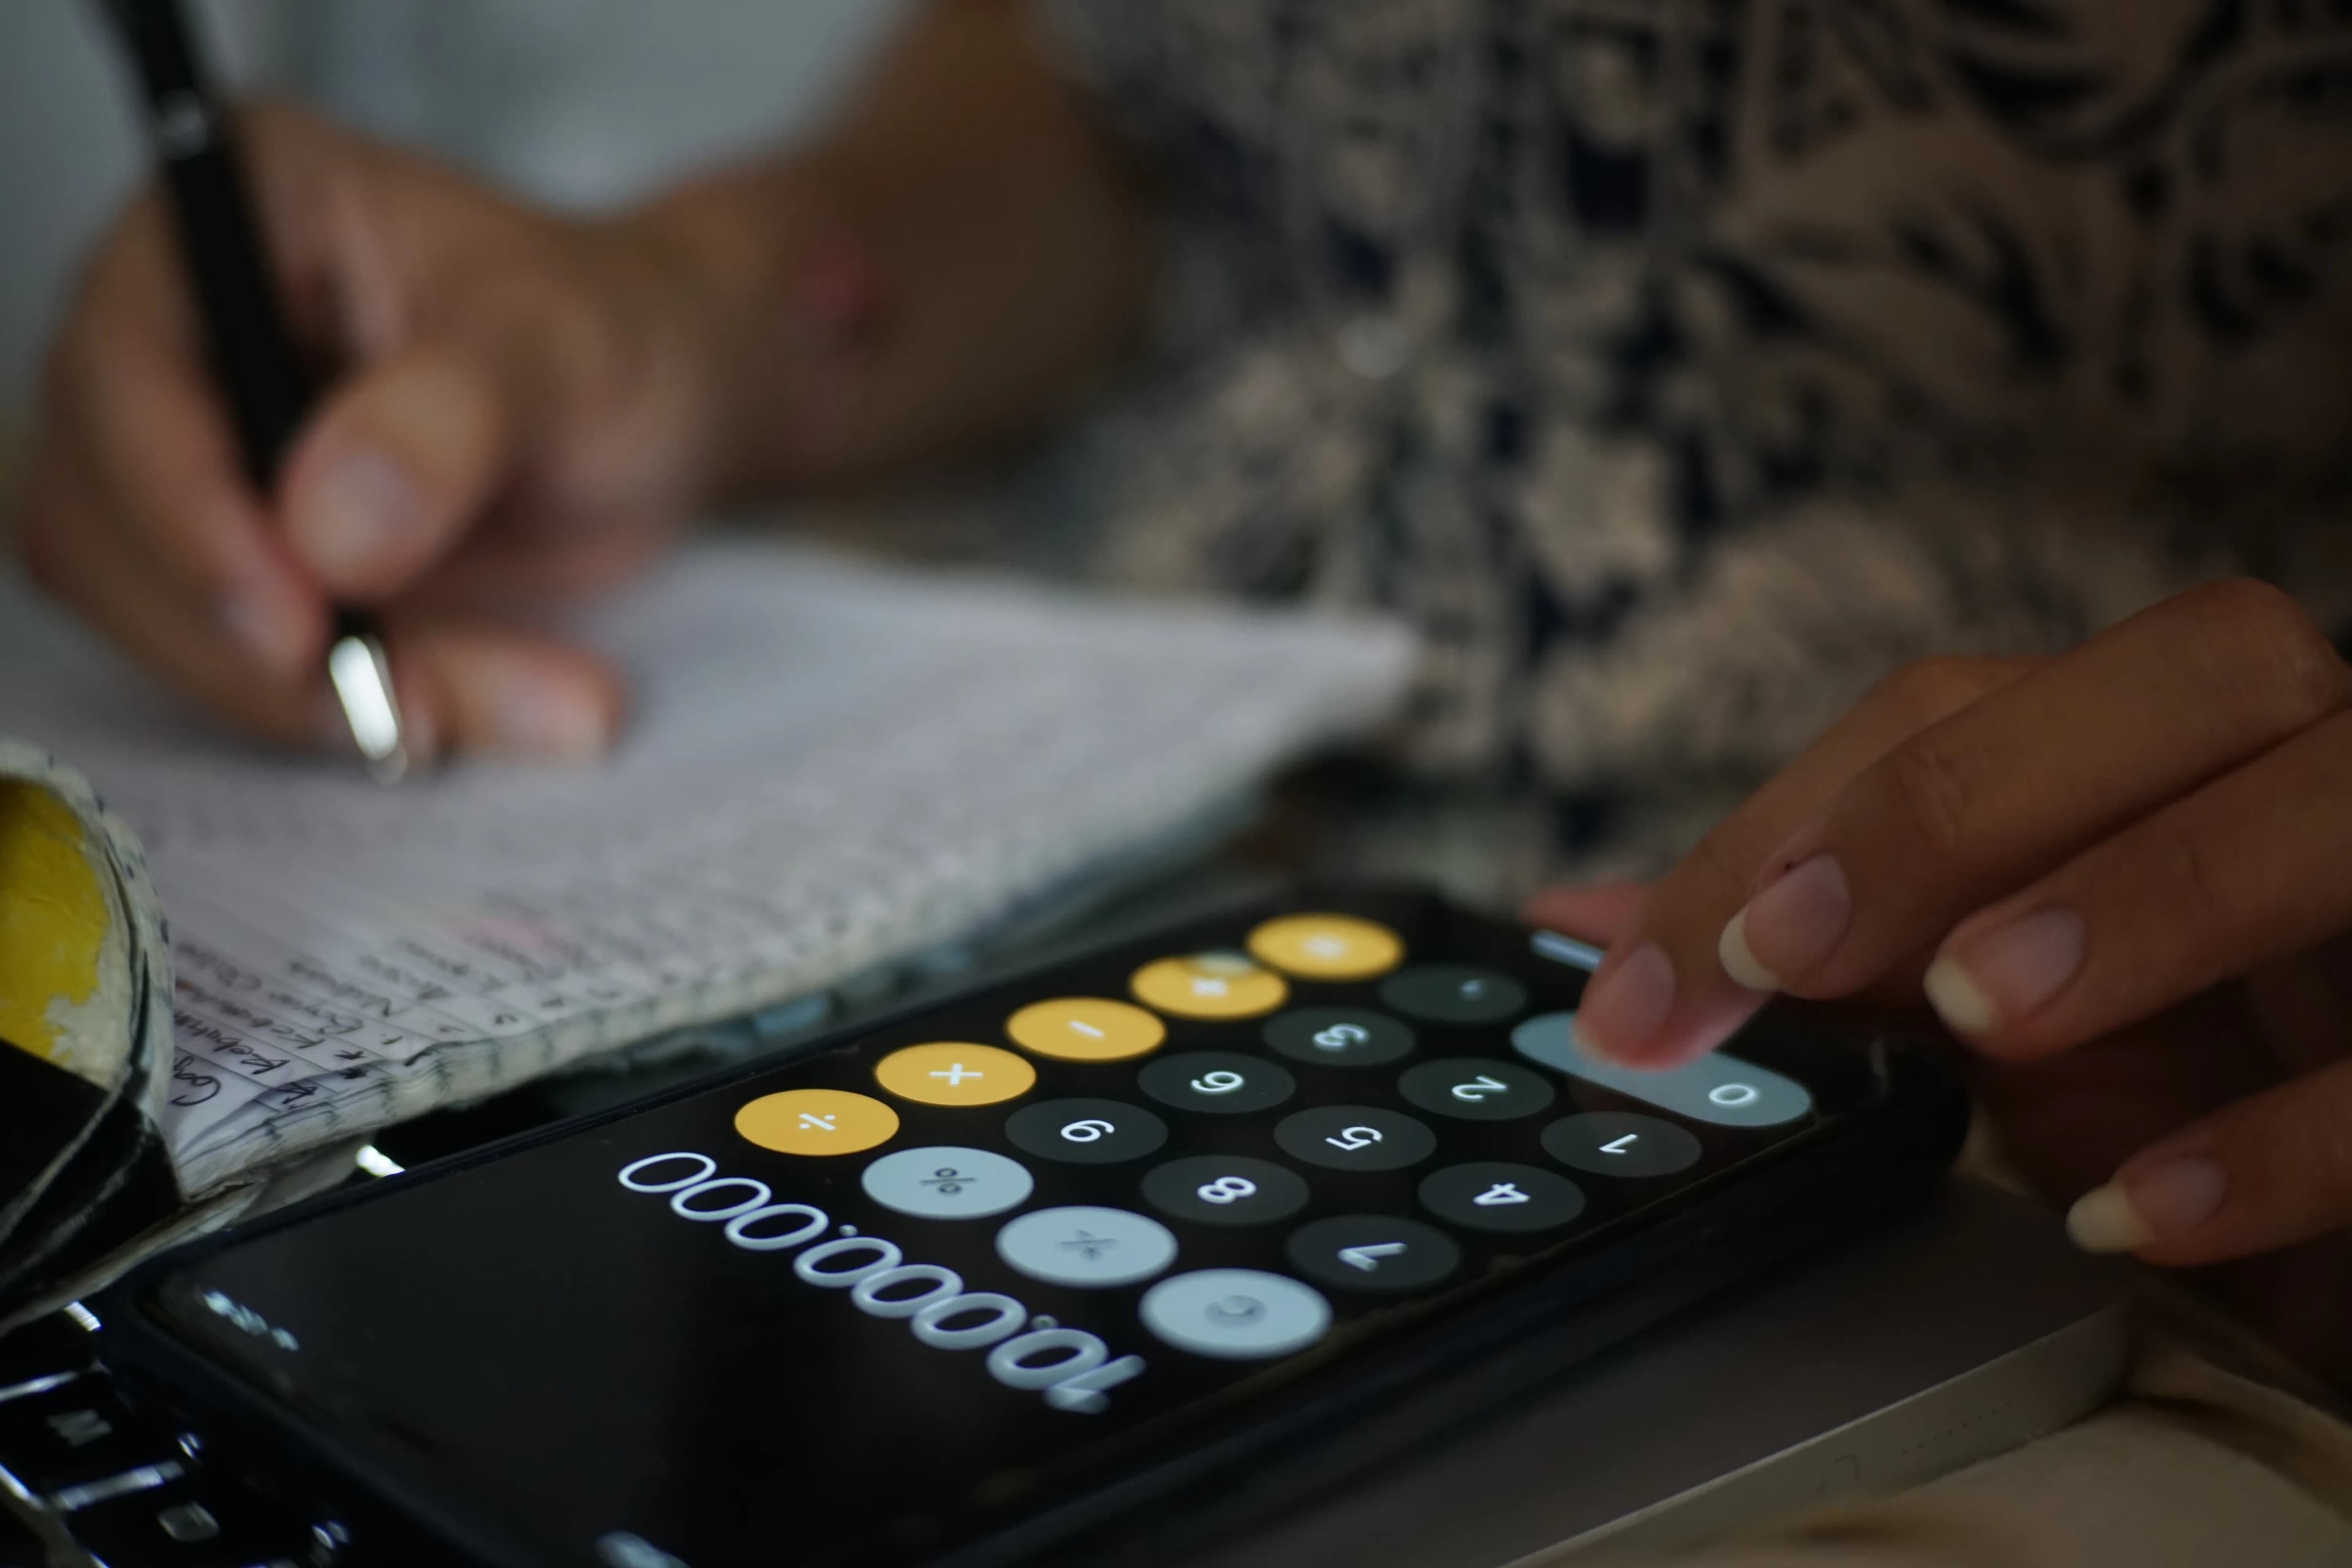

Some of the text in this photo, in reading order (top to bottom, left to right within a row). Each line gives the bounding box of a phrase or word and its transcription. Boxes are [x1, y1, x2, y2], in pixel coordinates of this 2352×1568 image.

[1313, 1023, 1368, 1049] 3
[1190, 1070, 1245, 1095] 6
[1451, 1076, 1507, 1101] 2
[1708, 1083, 1758, 1106] 0
[1060, 1118, 1115, 1144] 9
[1325, 1125, 1383, 1152] 5
[1598, 1133, 1638, 1155] 1
[1197, 1176, 1257, 1204] 8
[1473, 1182, 1531, 1207] 4
[1339, 1242, 1406, 1271] 7
[617, 1152, 1147, 1415] 10.000.000
